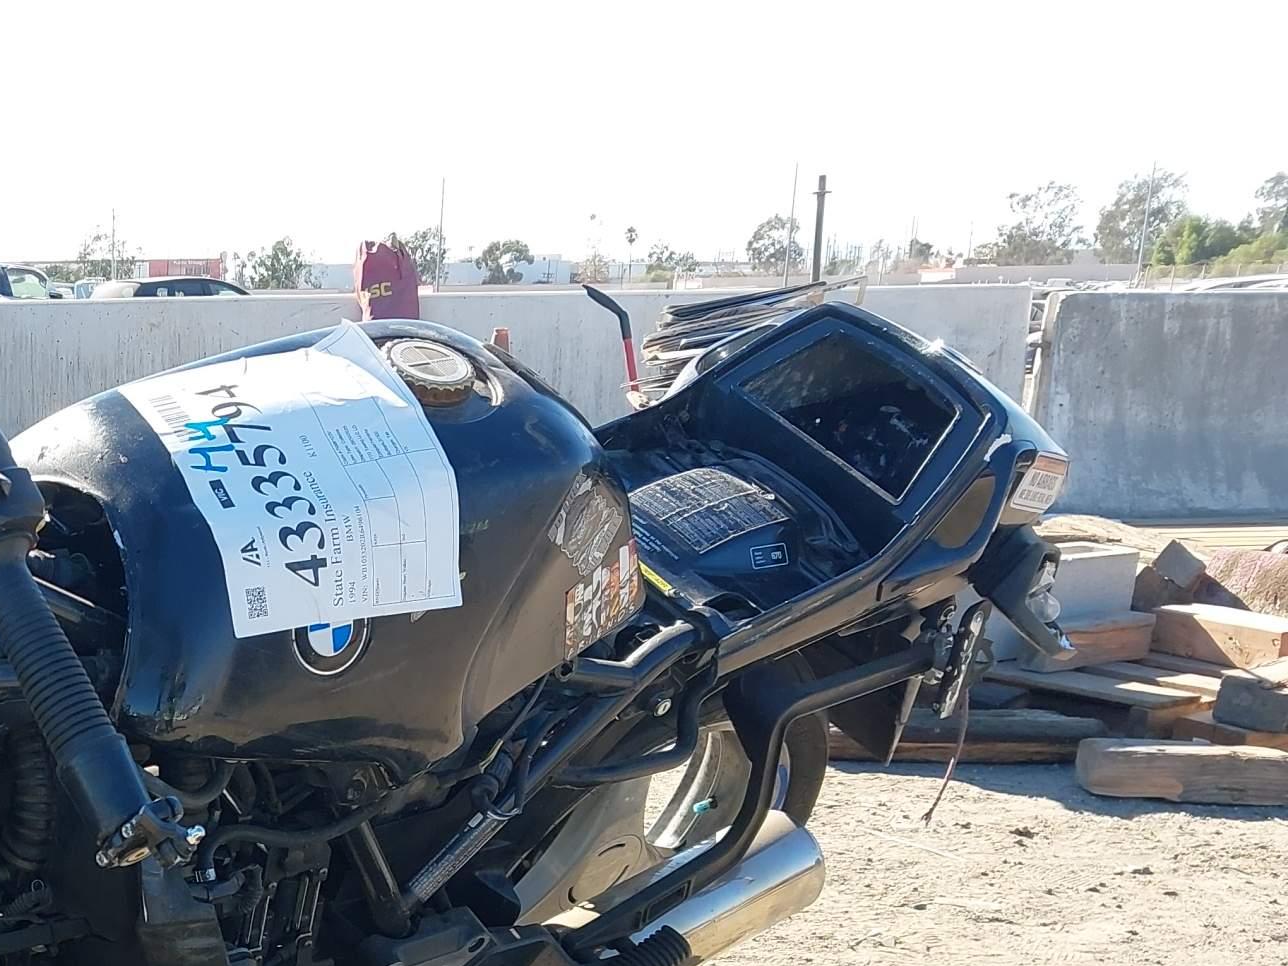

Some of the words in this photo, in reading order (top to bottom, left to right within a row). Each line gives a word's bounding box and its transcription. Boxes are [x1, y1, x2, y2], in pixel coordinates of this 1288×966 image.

[368, 281, 392, 298] SC
[195, 384, 328, 588] 43335794
[303, 471, 336, 523] Insurance
[330, 527, 343, 565] Farm
[343, 514, 354, 542] BMW
[333, 569, 344, 607] State
[348, 581, 356, 603] 1994
